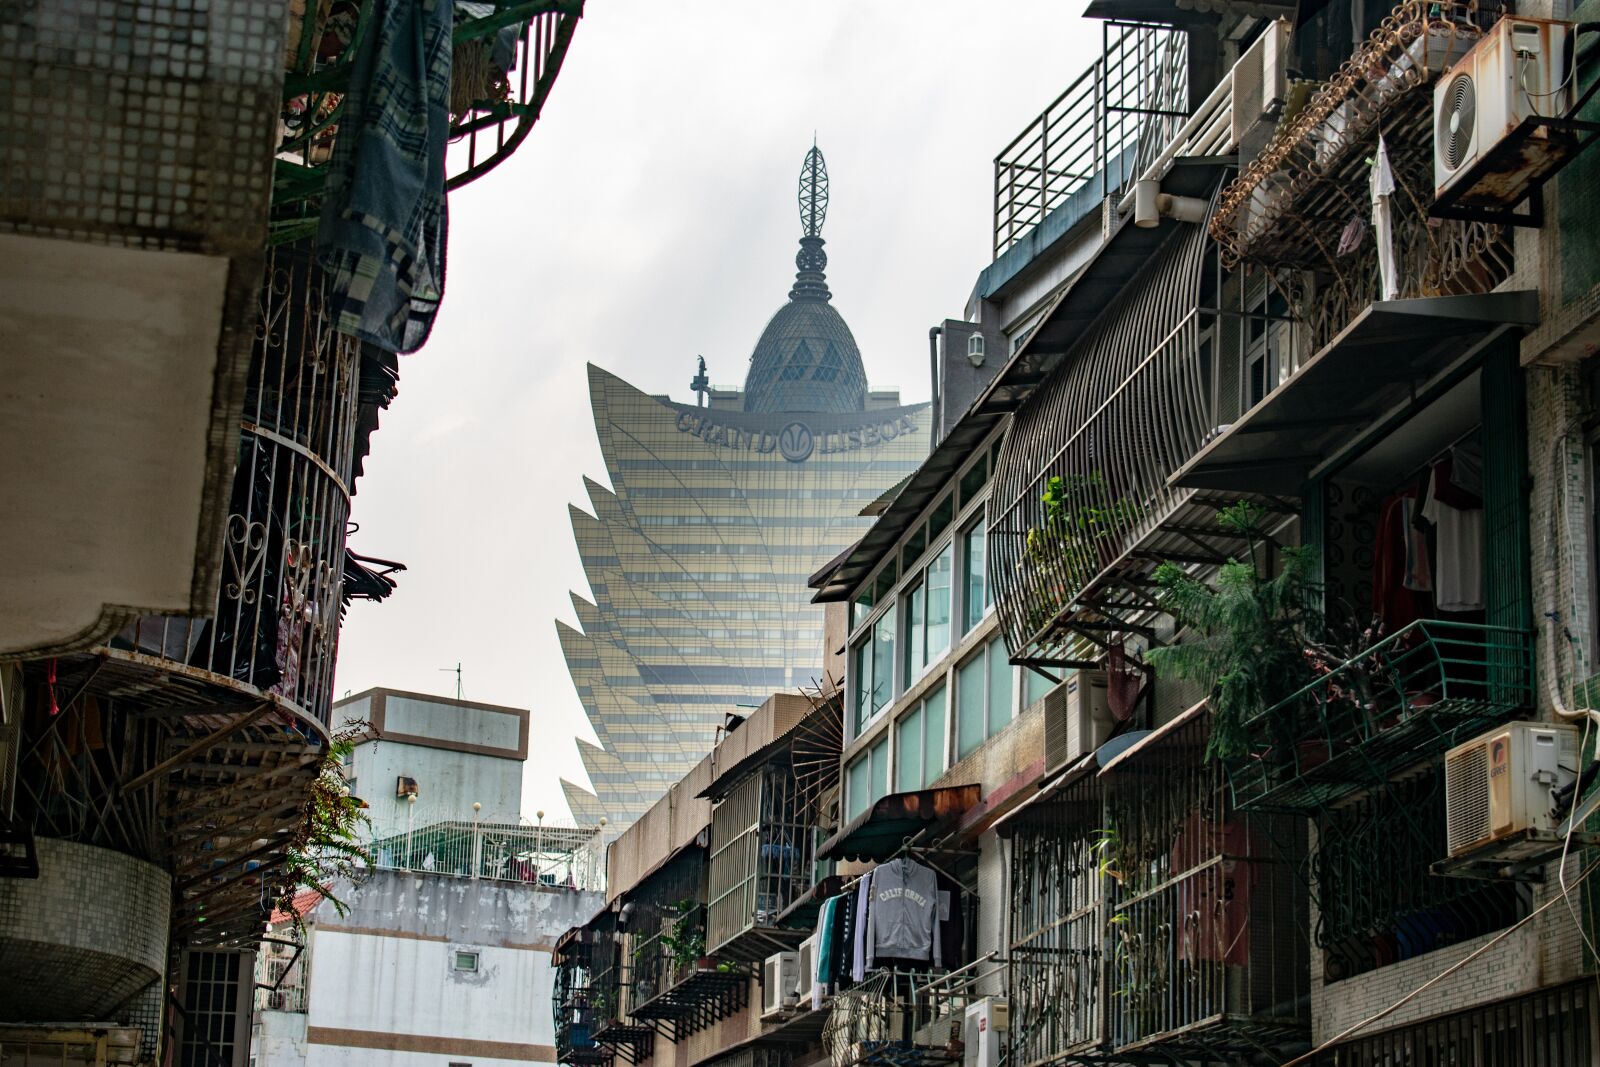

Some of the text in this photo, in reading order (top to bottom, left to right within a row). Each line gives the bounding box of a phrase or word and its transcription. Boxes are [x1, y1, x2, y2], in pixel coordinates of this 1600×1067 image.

[677, 411, 919, 454] GRAND LISBOA
[880, 888, 927, 907] CALIFORNIA
